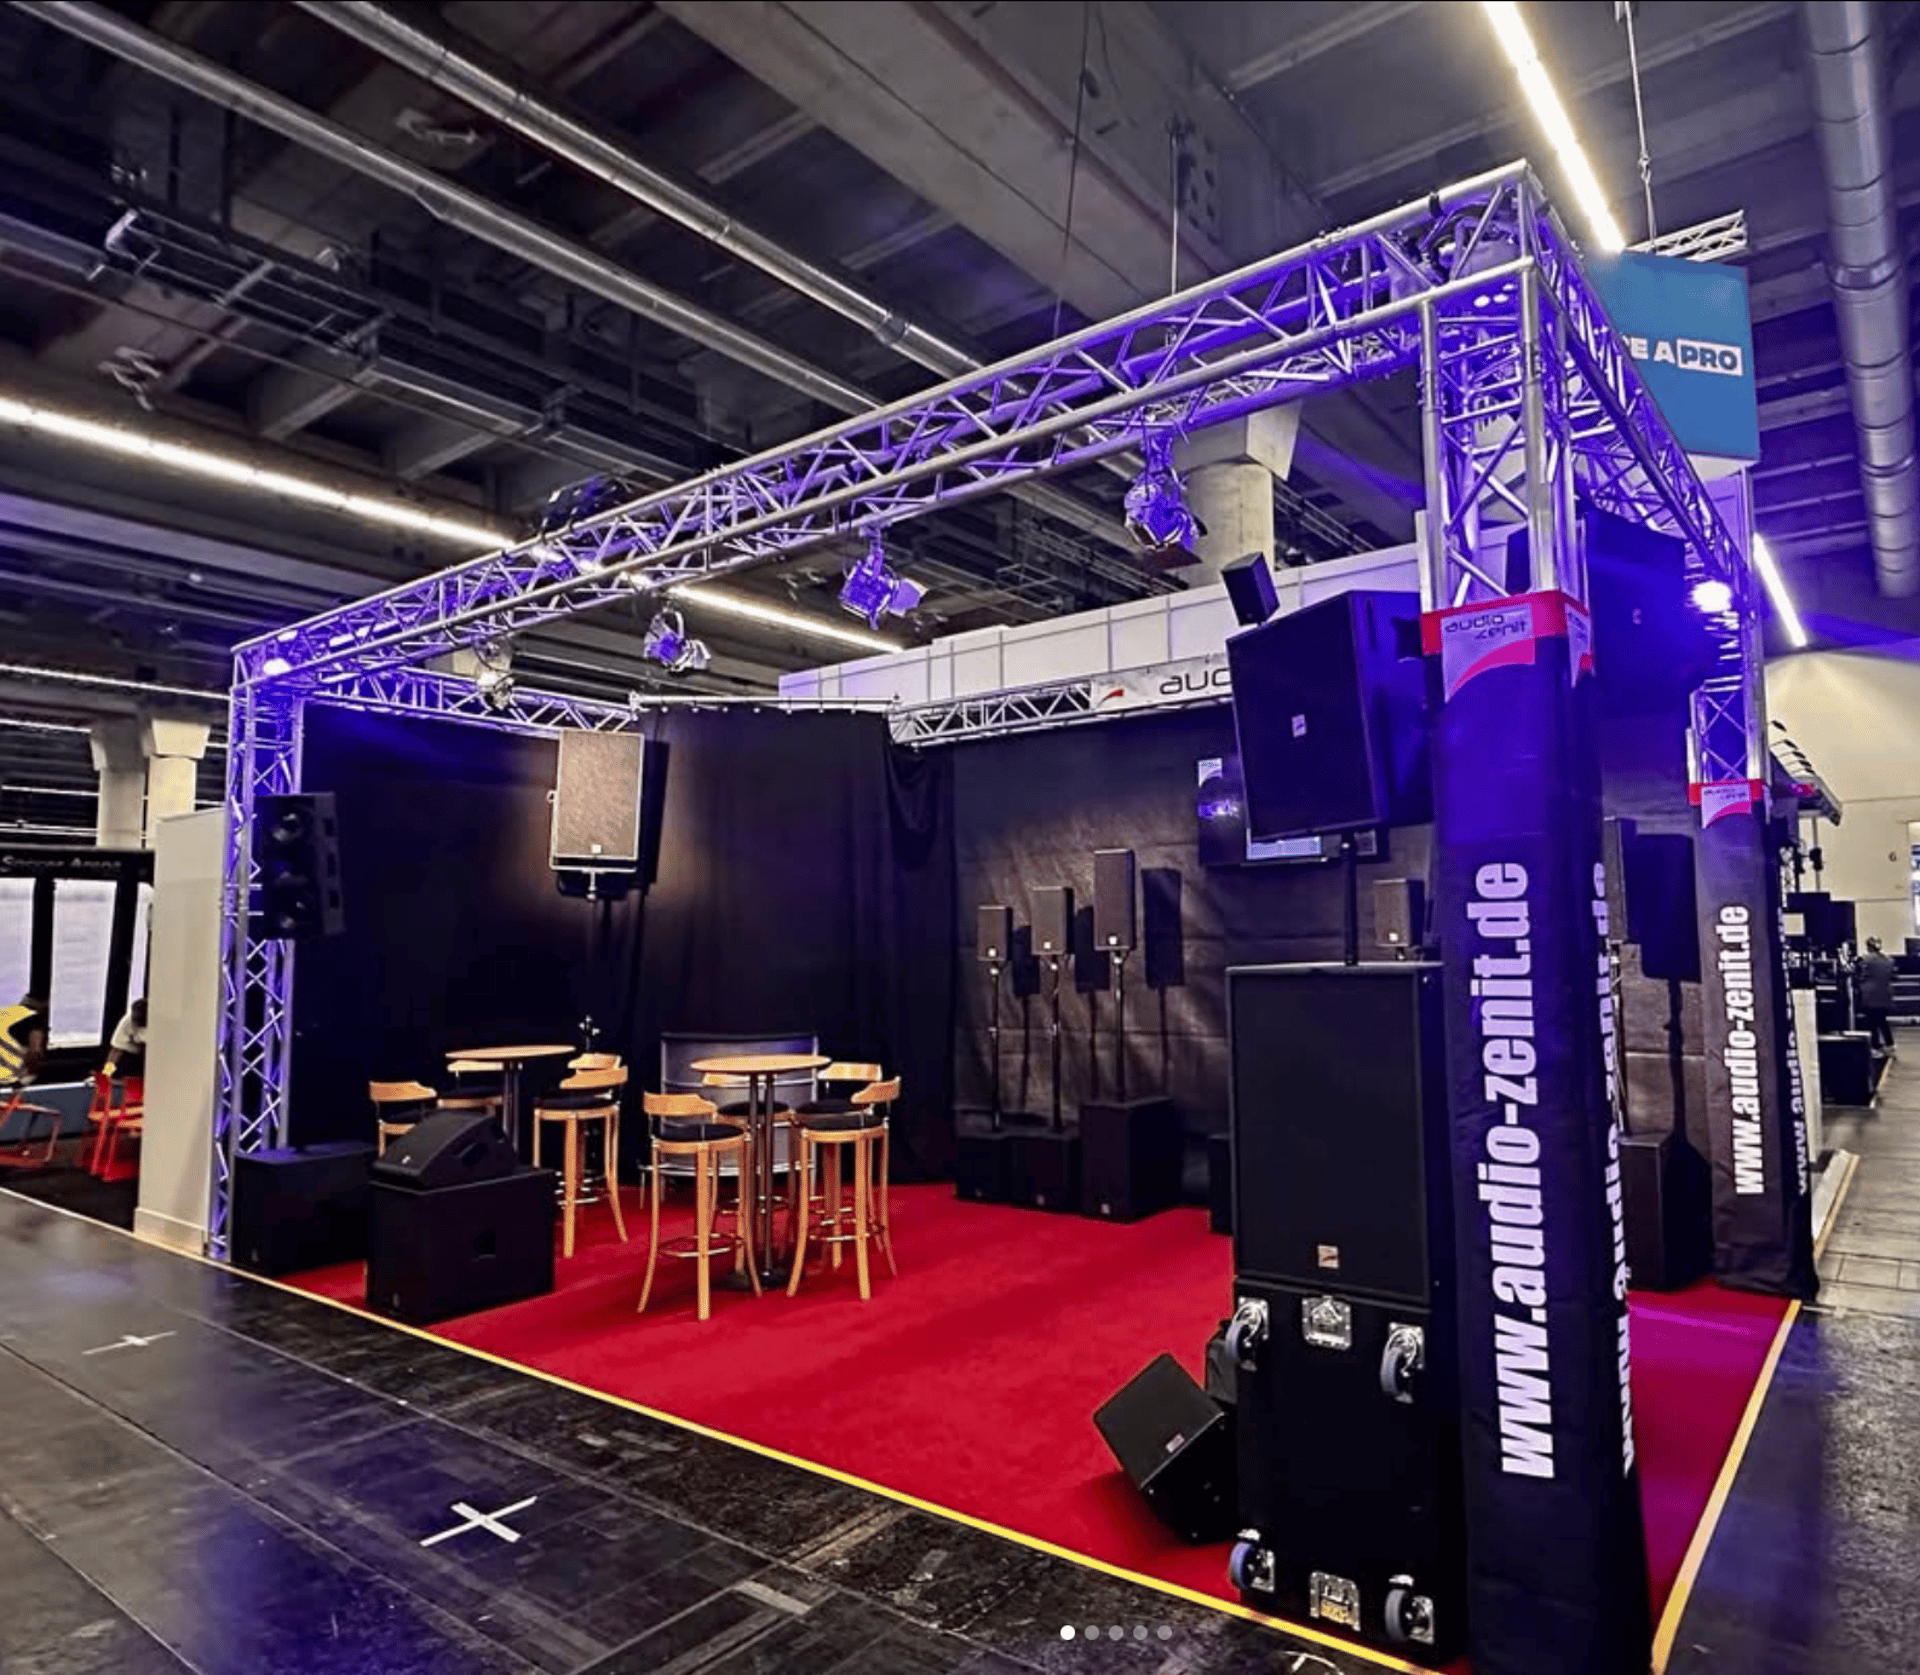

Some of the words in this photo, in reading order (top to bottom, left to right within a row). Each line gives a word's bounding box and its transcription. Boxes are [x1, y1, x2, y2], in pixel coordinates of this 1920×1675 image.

[1653, 341, 1676, 364] A
[1680, 344, 1738, 371] PRO
[1445, 614, 1504, 633] audio
[1716, 906, 1764, 1194] www.audio-zenit.de
[1467, 863, 1555, 1479] www.audio-zenit.de
